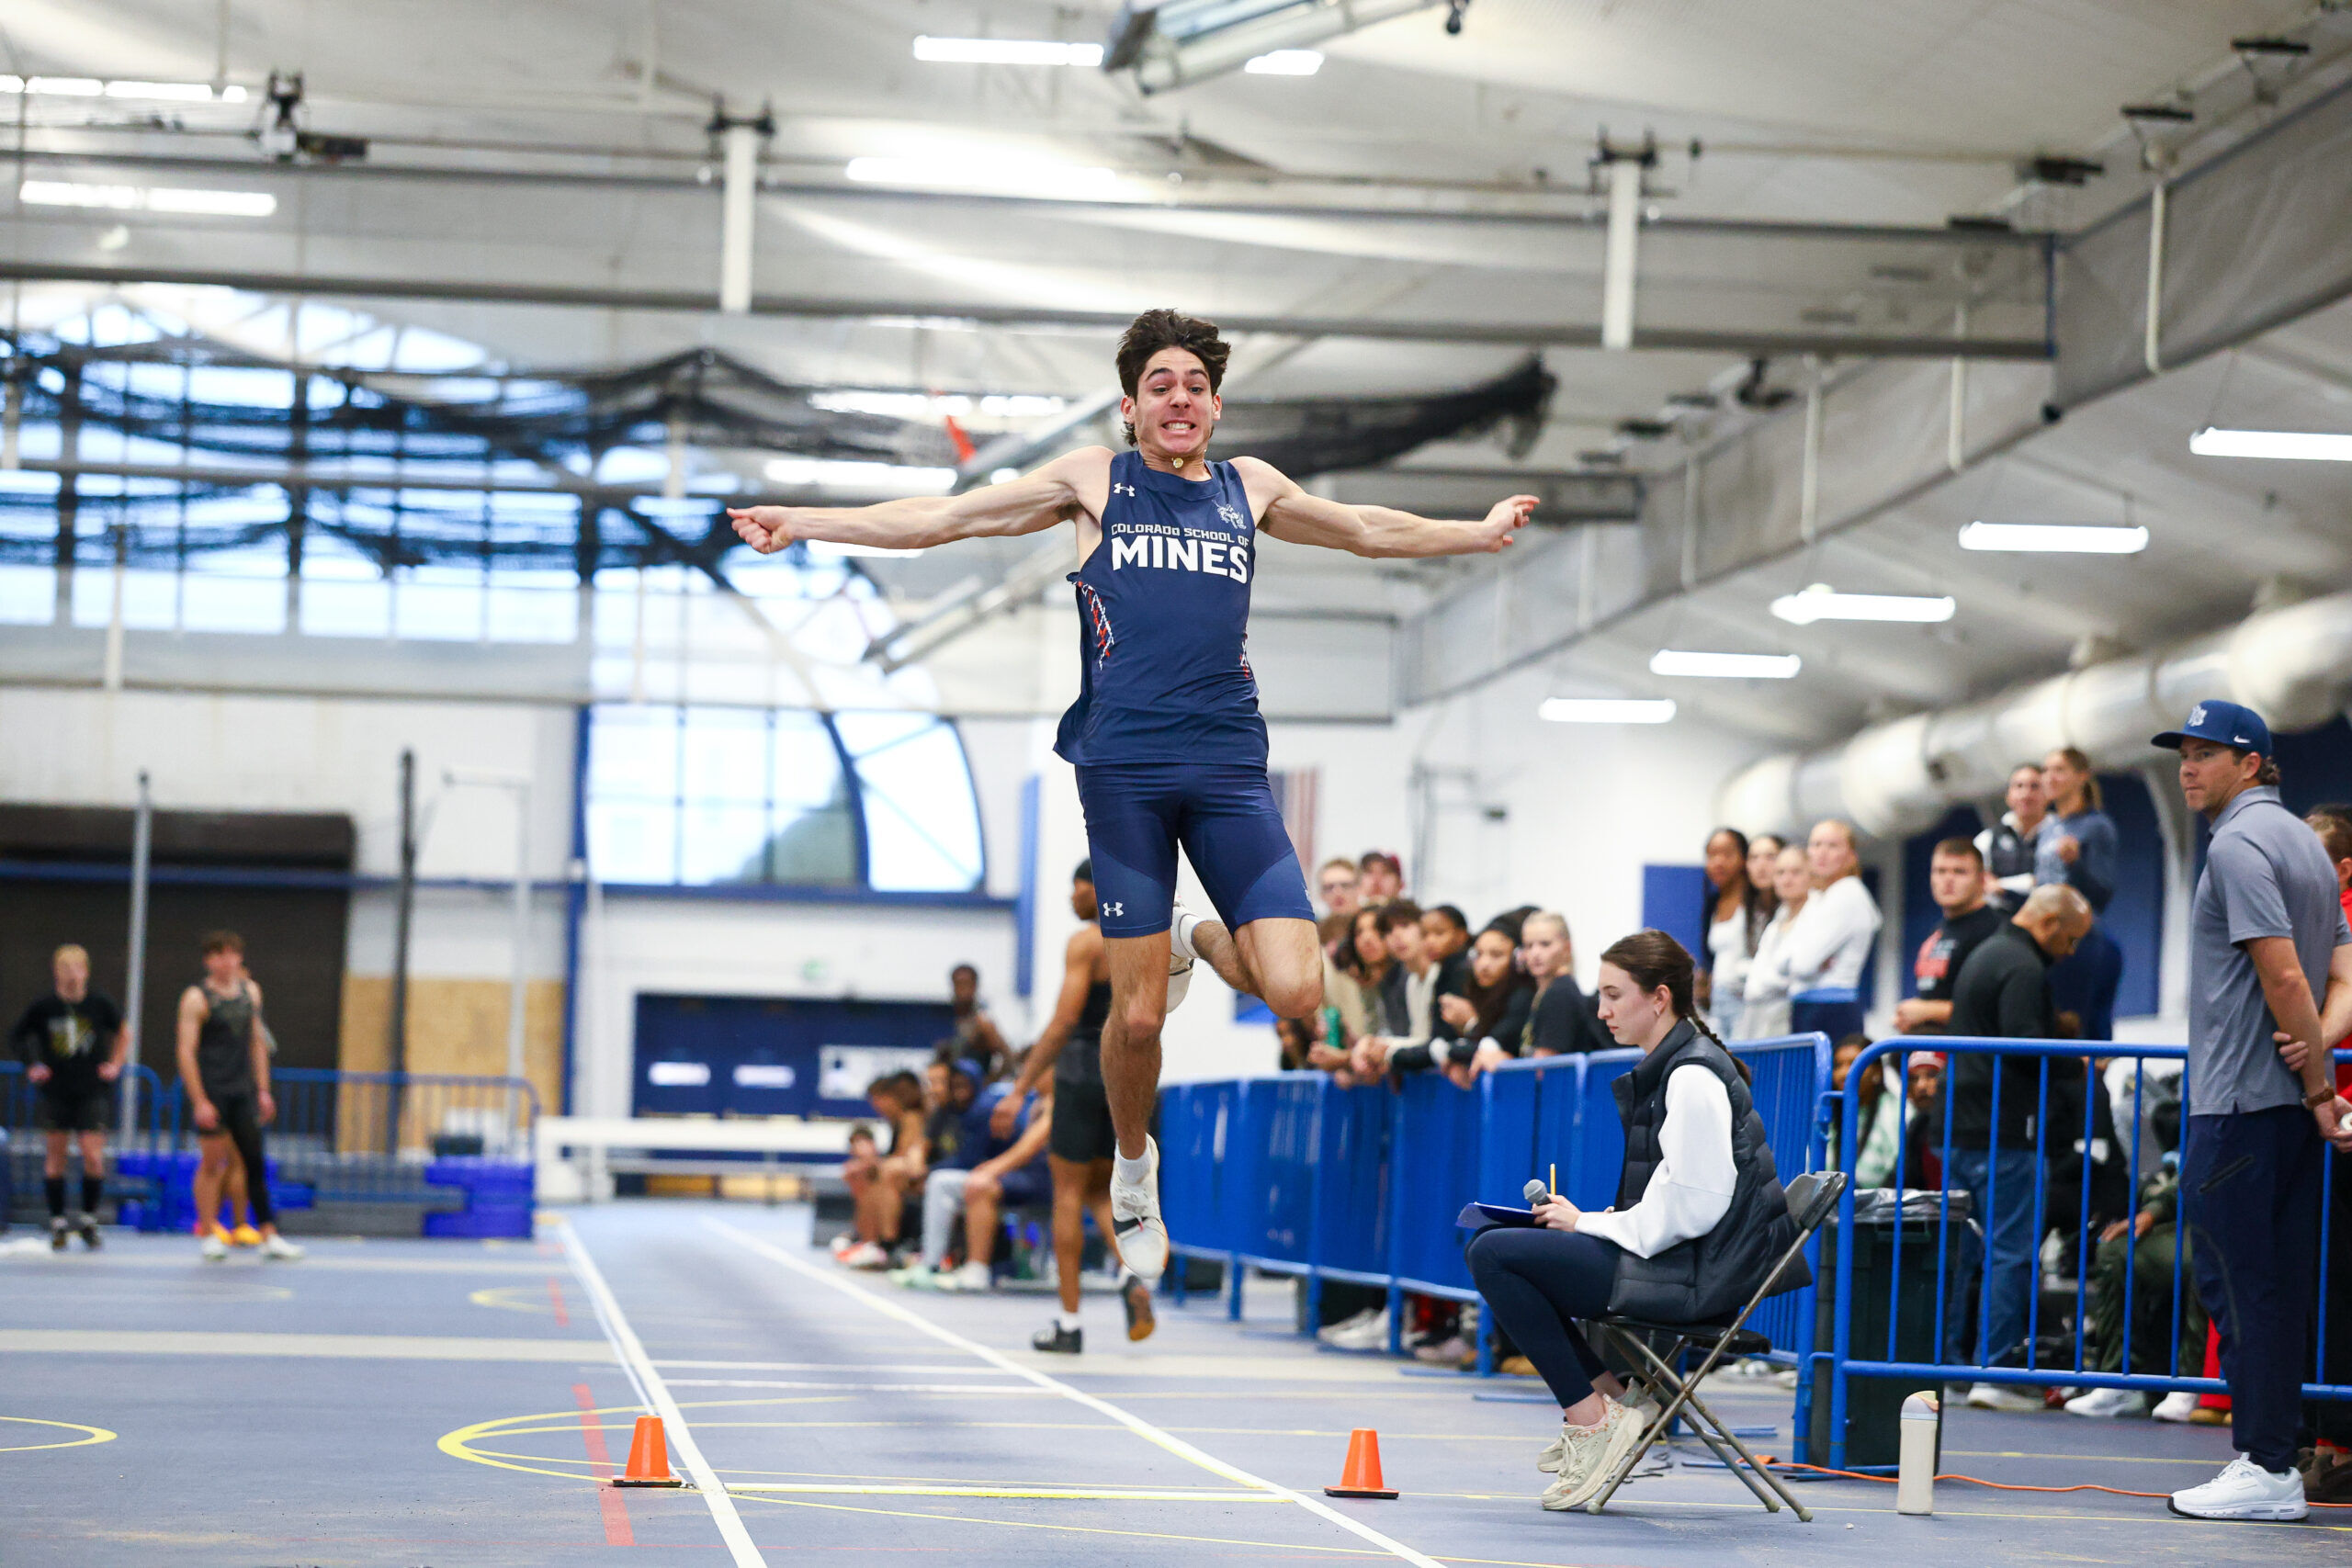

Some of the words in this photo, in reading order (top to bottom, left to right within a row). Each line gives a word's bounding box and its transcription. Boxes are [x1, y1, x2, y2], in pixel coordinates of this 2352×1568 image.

[1111, 523, 1181, 536] COLORADO
[1183, 527, 1235, 543] SCHOOL
[1238, 535, 1250, 547] OF
[1111, 535, 1248, 584] MINES
